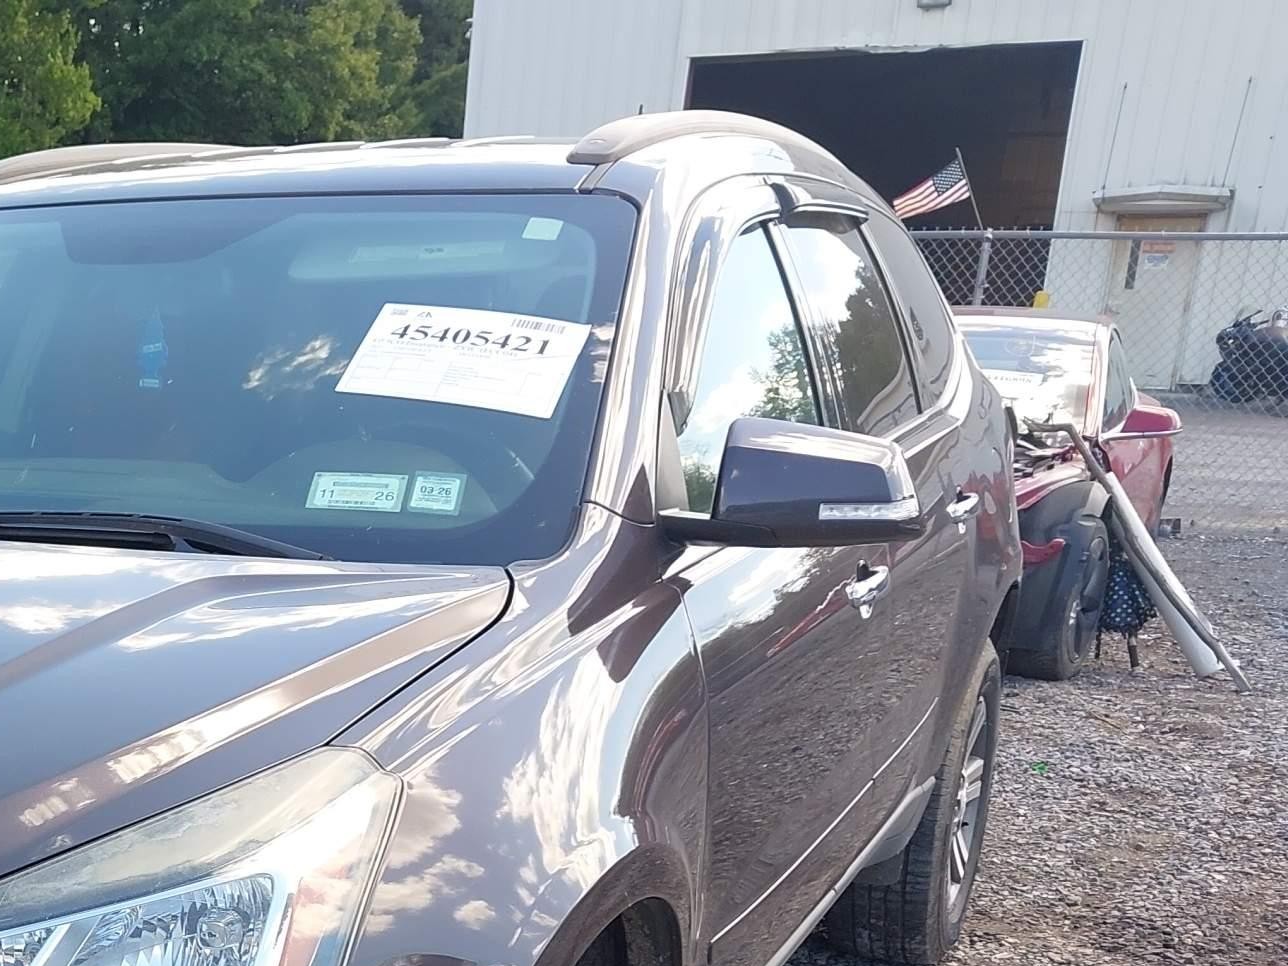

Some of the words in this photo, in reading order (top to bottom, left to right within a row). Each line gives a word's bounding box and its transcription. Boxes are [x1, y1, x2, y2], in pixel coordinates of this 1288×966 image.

[391, 324, 551, 355] 45405421
[320, 488, 335, 498] 11
[374, 491, 395, 501] 26
